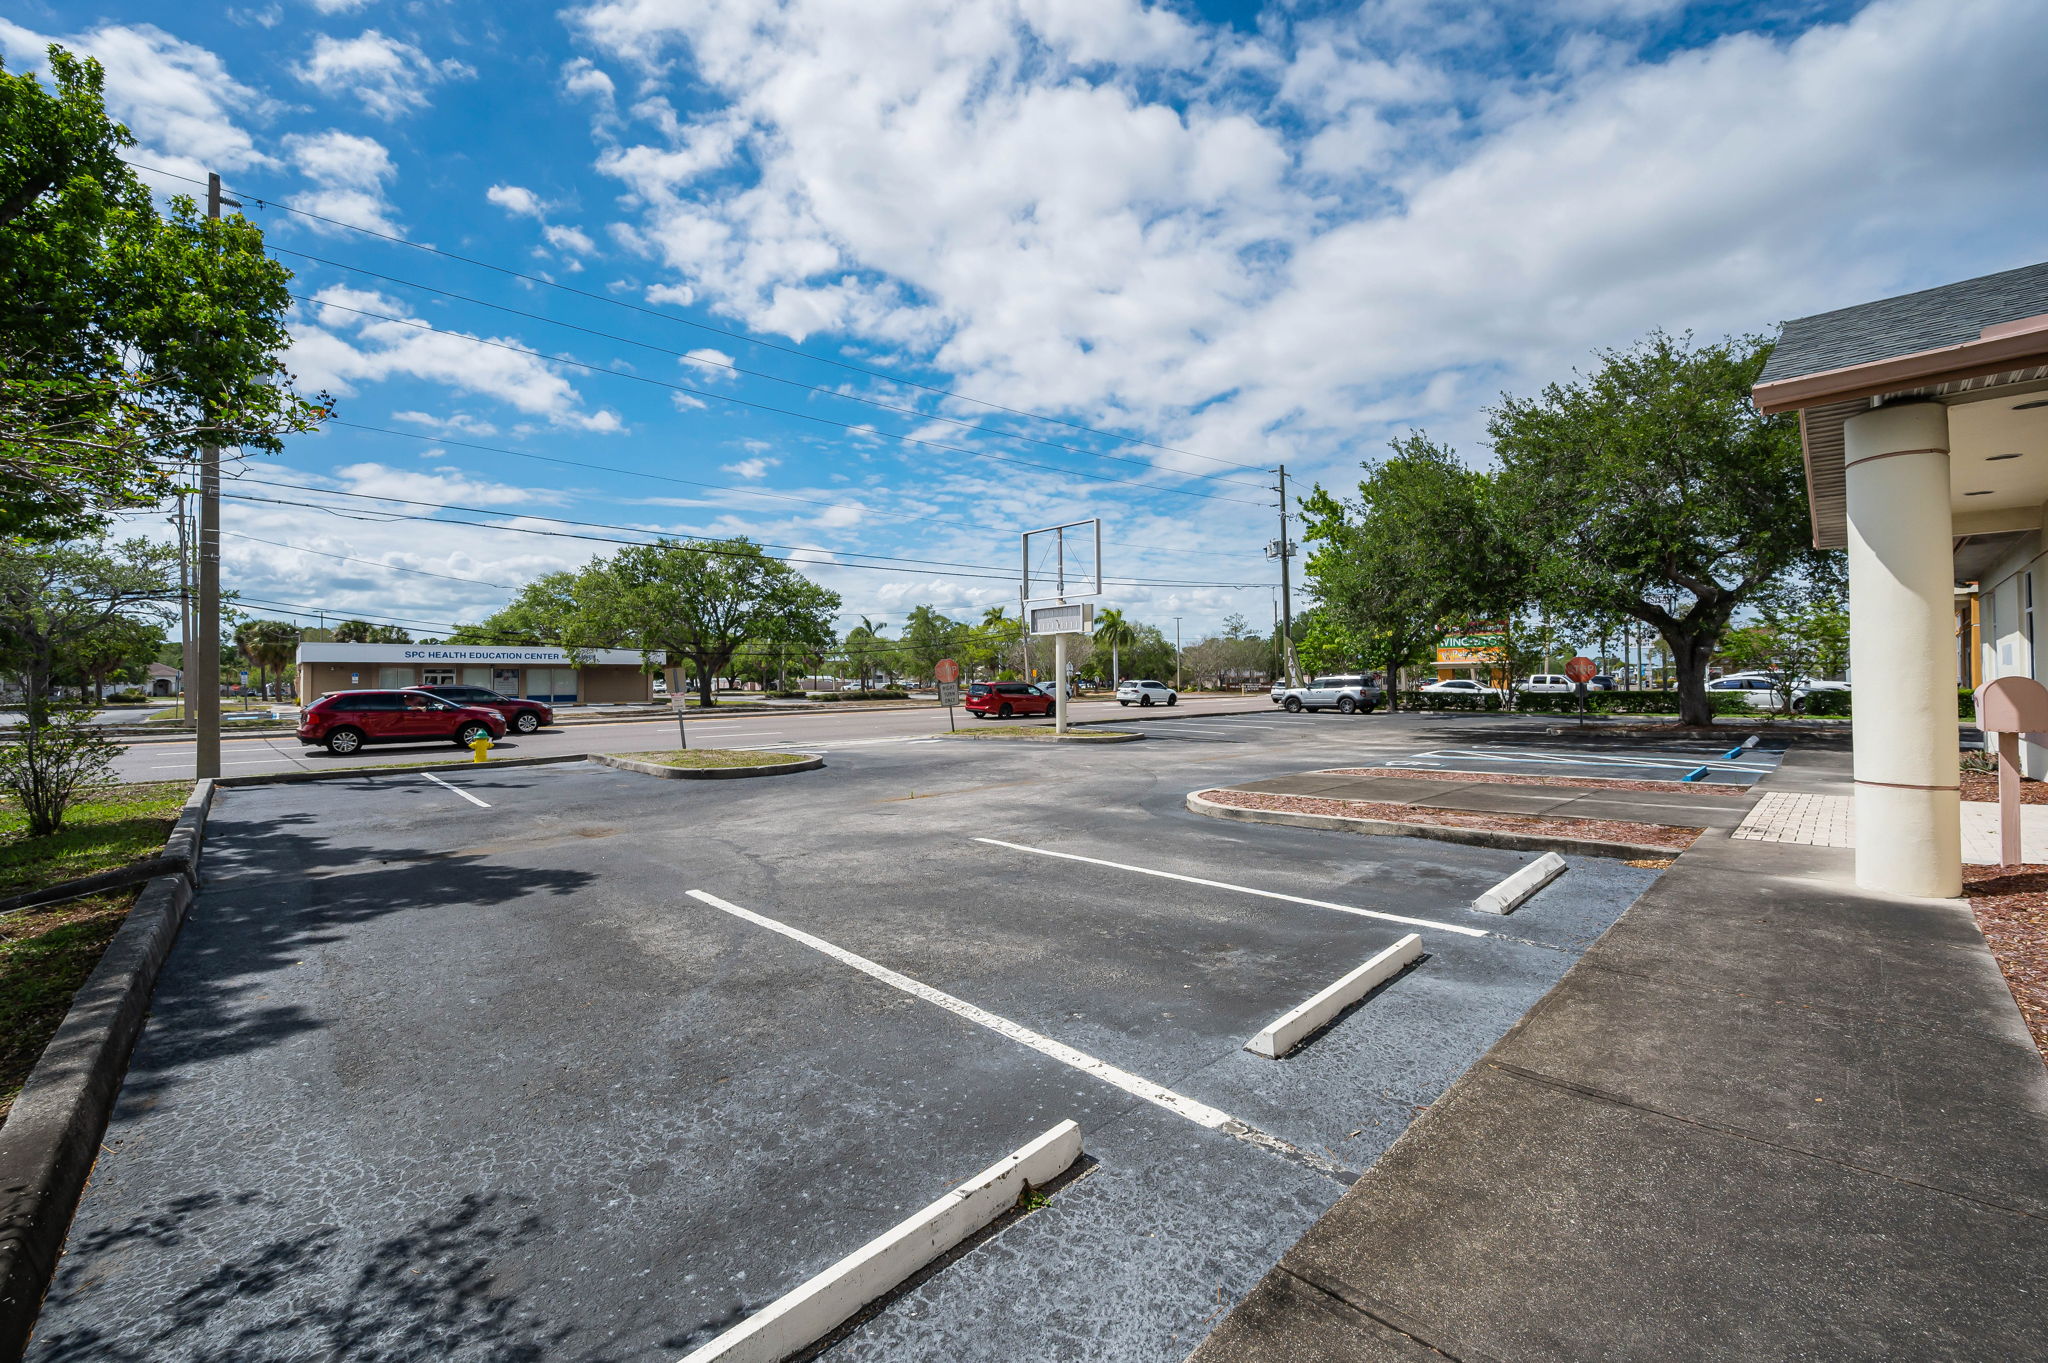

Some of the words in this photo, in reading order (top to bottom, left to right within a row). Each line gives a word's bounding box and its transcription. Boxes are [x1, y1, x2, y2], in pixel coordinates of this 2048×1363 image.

[404, 651, 425, 659] SPC
[428, 651, 466, 659] HEALTH
[469, 652, 522, 660] EDUCATION
[1567, 664, 1594, 675] STOP
